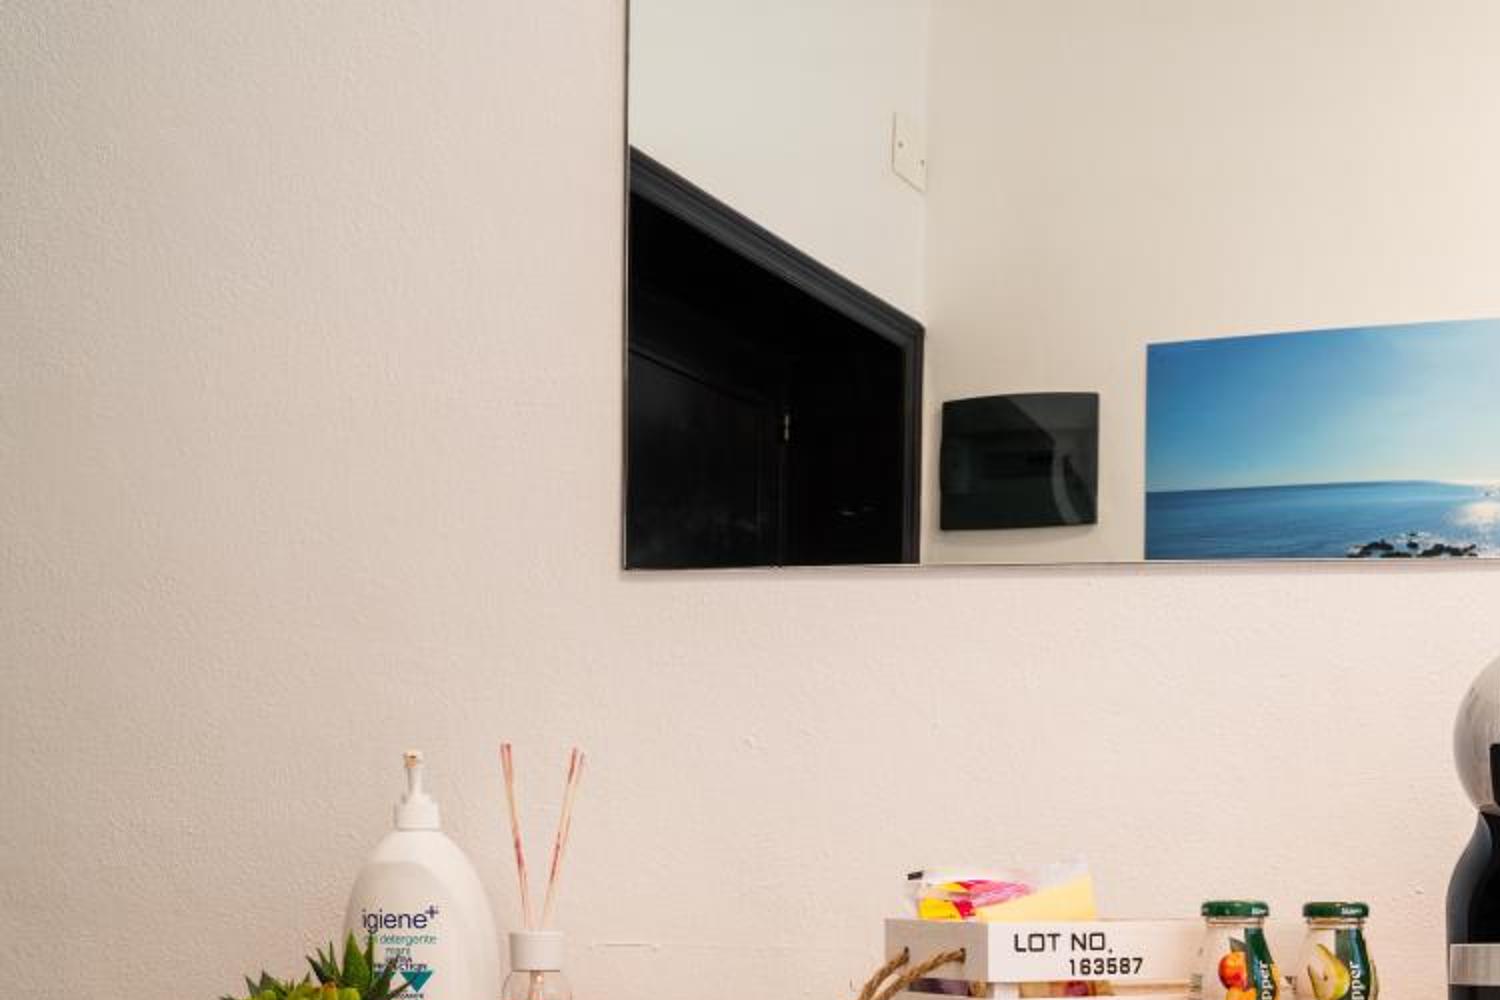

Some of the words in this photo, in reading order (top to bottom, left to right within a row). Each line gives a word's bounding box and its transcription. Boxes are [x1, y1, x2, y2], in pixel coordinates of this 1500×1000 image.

[1013, 933, 1062, 953] LOT
[1071, 932, 1113, 954] NO.
[1069, 957, 1144, 976] 163587
